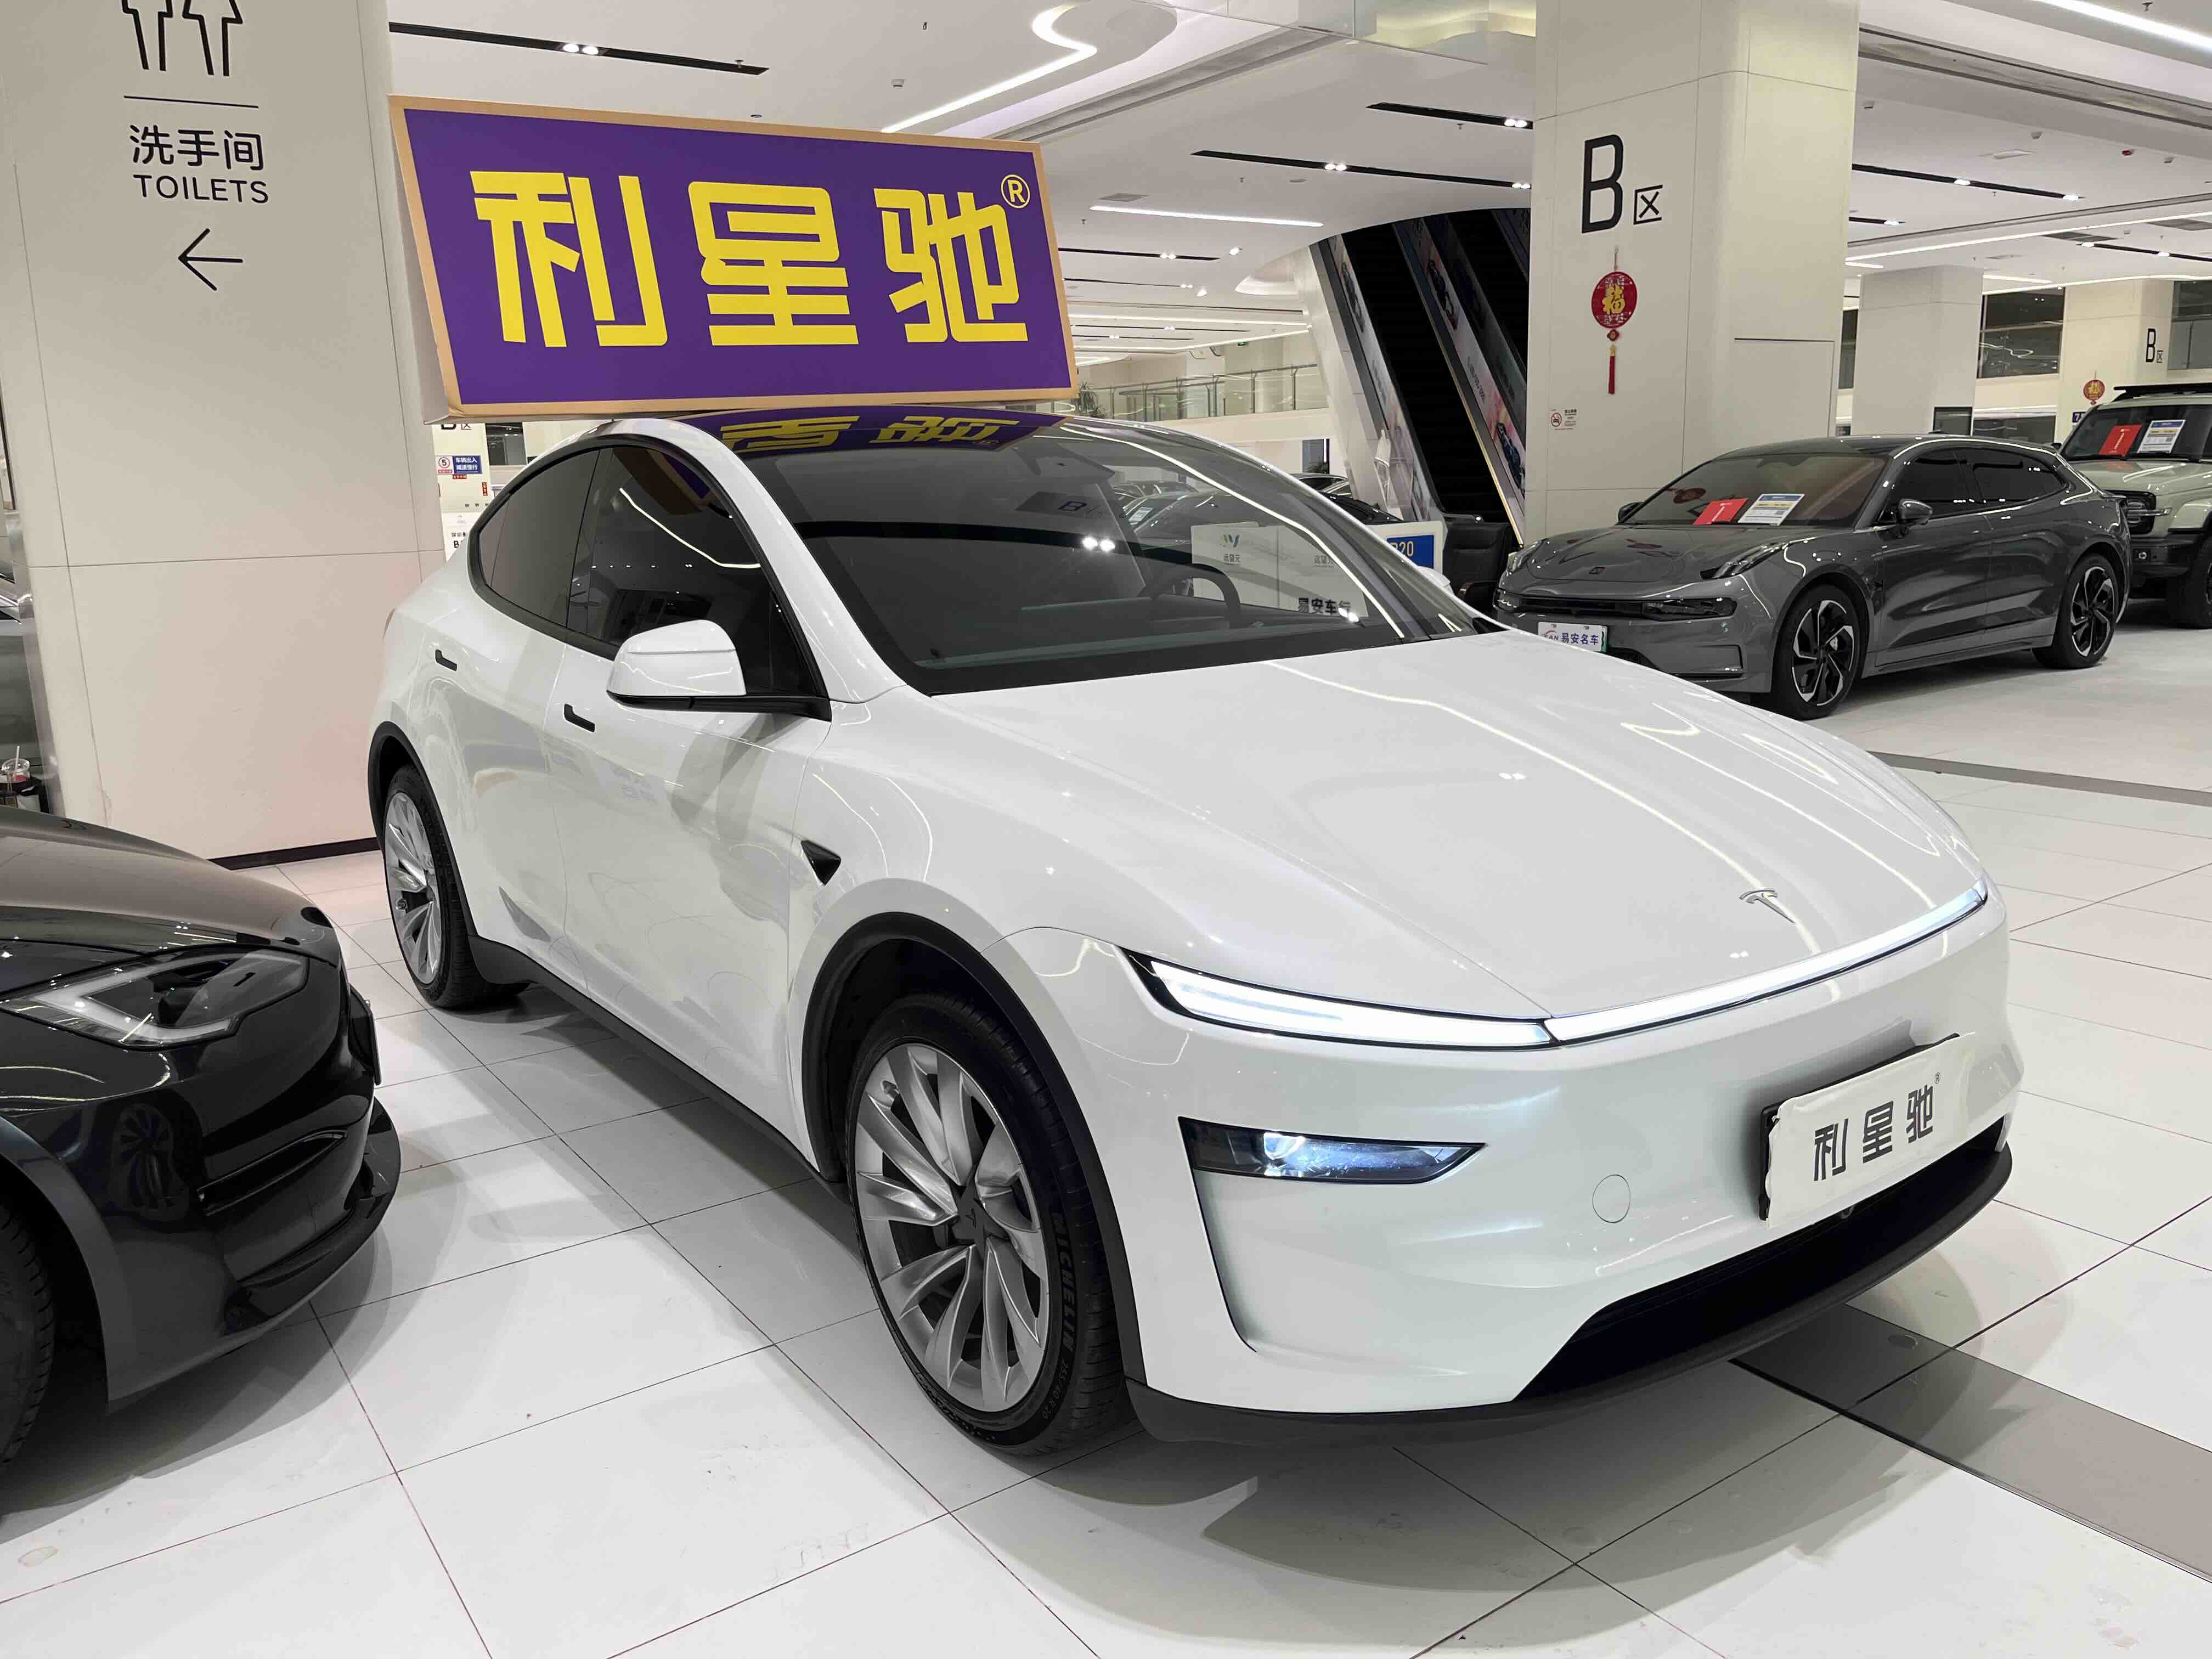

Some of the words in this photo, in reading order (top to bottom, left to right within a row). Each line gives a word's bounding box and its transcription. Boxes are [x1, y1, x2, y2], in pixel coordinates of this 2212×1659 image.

[129, 125, 264, 171] 洗手间
[133, 174, 269, 204] TOILETS
[470, 170, 1029, 347] 利星驰
[1561, 633, 1599, 645] 易安名车
[1813, 1085, 1933, 1181] 利星驰
[1052, 1212, 1076, 1352] MICHELIN
